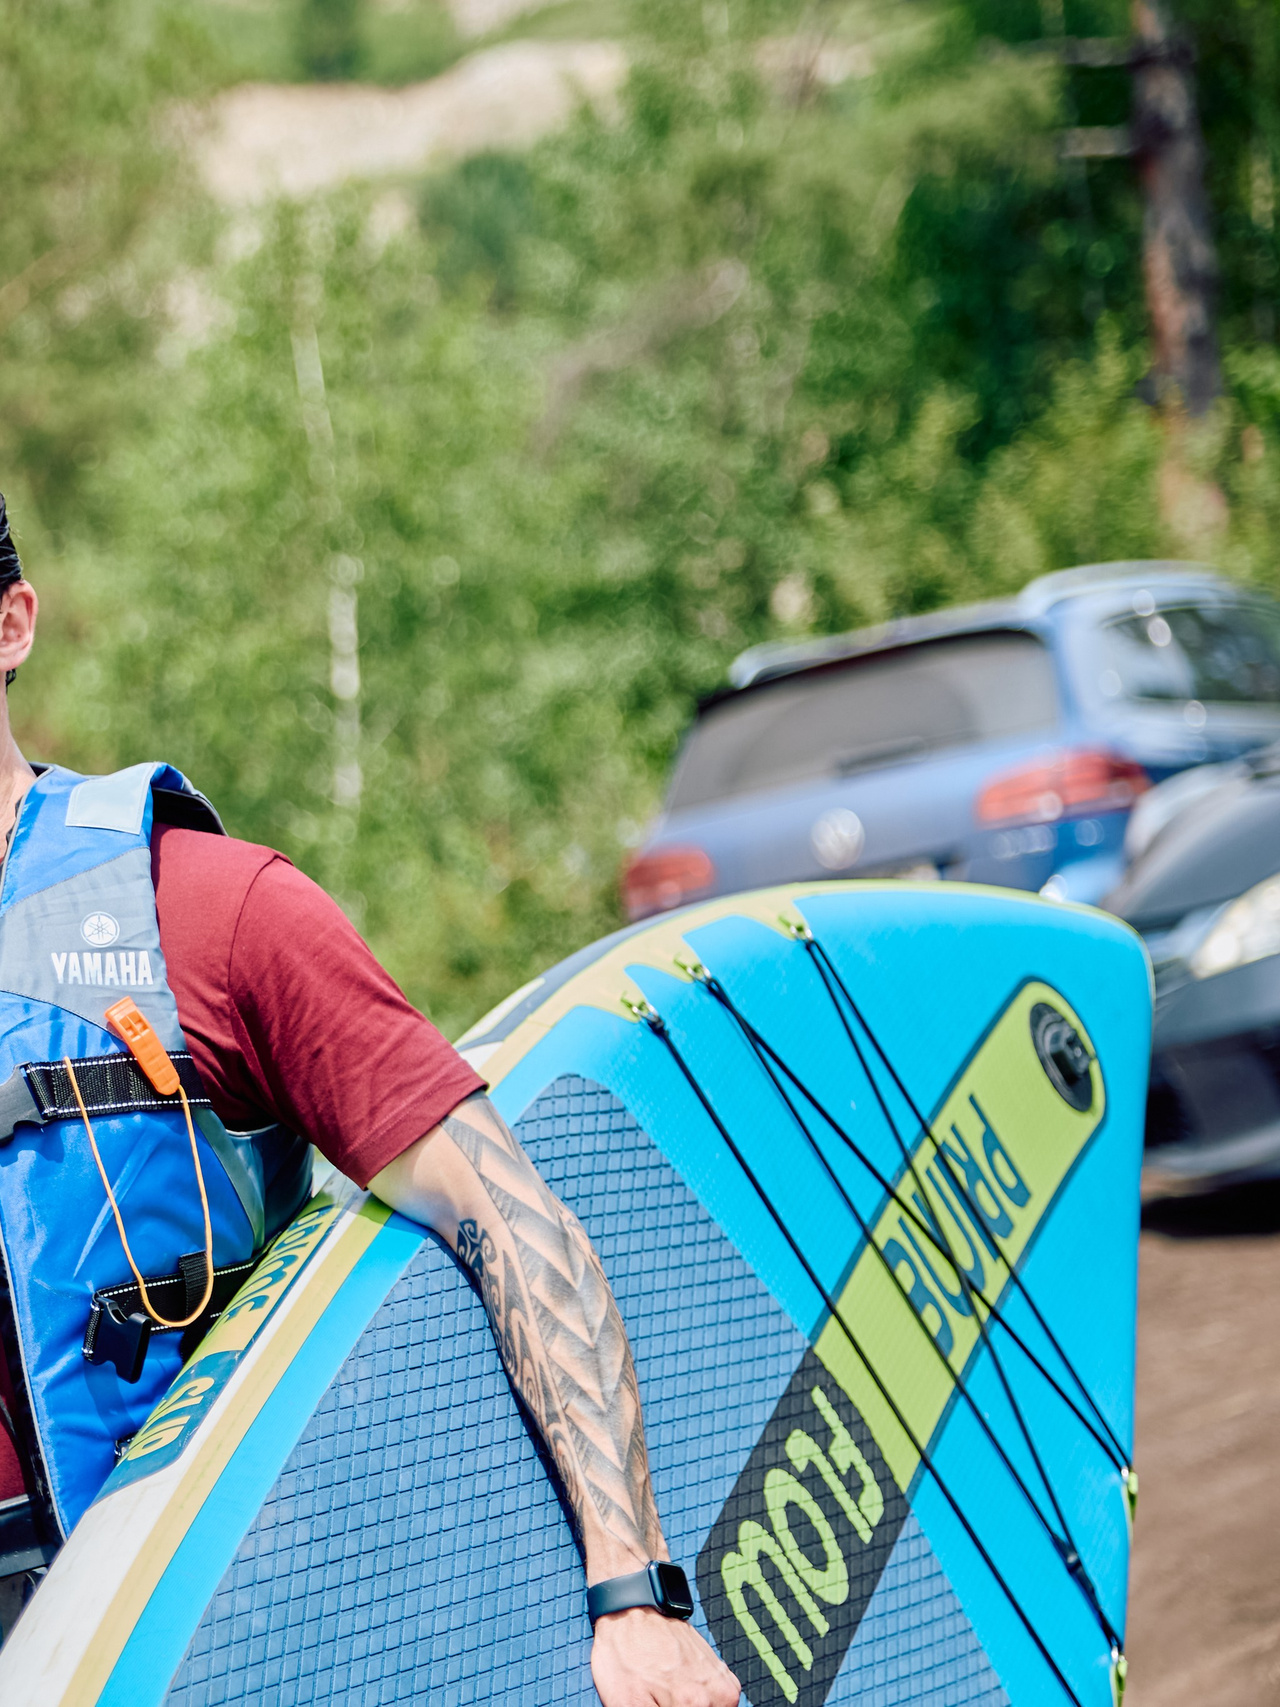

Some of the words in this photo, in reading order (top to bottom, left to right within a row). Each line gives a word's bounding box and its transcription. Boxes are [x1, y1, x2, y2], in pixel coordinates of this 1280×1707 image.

[51, 951, 153, 985] YAMAHA
[881, 1094, 1031, 1357] PRIME
[720, 1386, 884, 1703] FLOW
